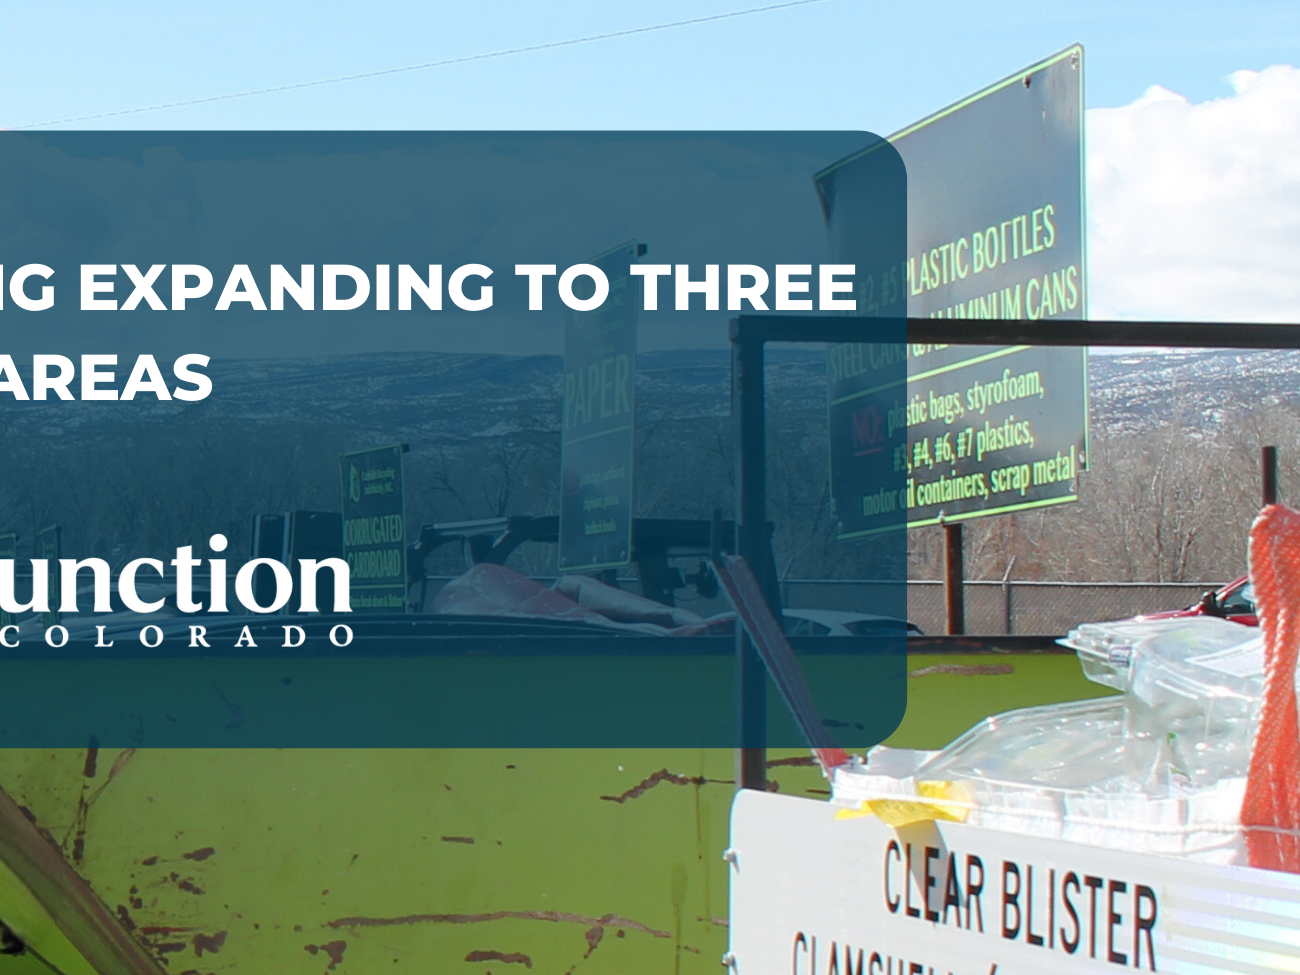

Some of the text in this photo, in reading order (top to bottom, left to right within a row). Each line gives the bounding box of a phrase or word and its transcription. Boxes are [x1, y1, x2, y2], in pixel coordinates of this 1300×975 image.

[902, 237, 969, 298] PLASTIC
[972, 204, 1055, 274] BOTTLES
[1026, 264, 1078, 321] CANS
[564, 353, 631, 430] PAPER
[887, 392, 927, 438] plastic
[929, 390, 965, 424] bags,
[966, 368, 1044, 415] styrofoam,
[913, 437, 933, 470] #4,
[934, 431, 956, 465] #6,
[956, 427, 974, 459] #7
[976, 415, 1035, 462] plastics,
[862, 444, 1076, 516] motor oil containers, scrap metal
[344, 514, 403, 547] CORRUGATED
[348, 549, 402, 580] CARDBOARD
[884, 839, 1157, 973] CLEAR BLISTER
